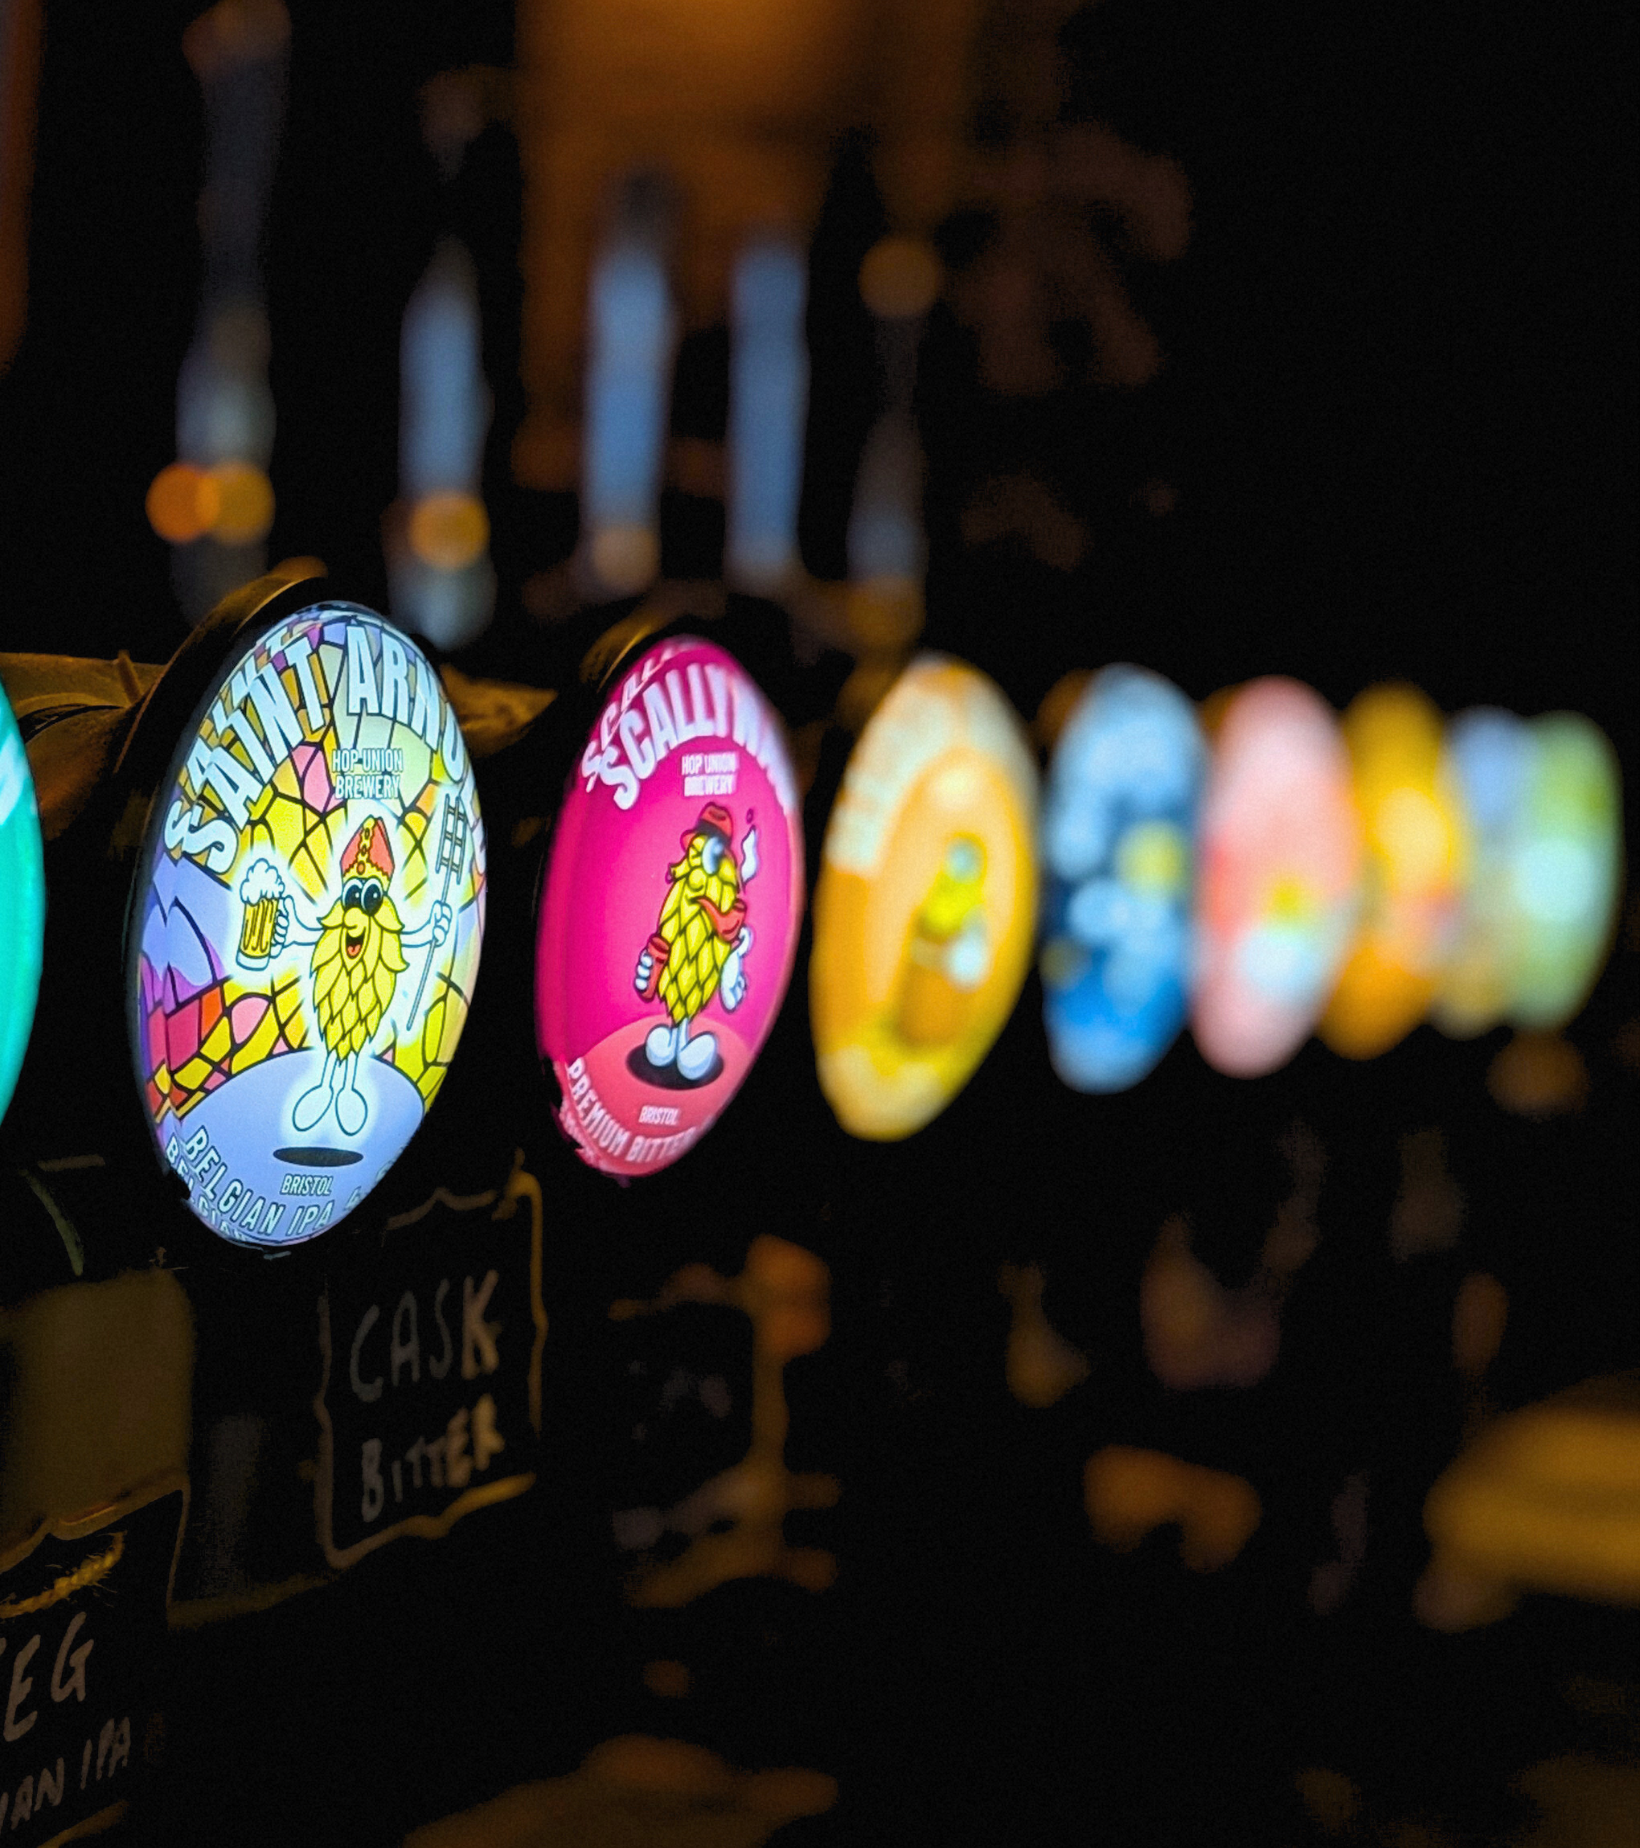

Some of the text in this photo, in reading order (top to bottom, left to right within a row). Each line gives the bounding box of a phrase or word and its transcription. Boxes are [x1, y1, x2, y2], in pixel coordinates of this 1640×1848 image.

[182, 636, 326, 875] SAINT
[332, 748, 403, 773] HOP UNION
[334, 774, 400, 800] BREWERY
[568, 1057, 631, 1158] PREMIUM
[639, 1105, 679, 1126] BRISTOL
[184, 1124, 286, 1236] BELGIAN
[286, 1200, 335, 1237] IPA
[280, 1173, 333, 1197] BRISTOL
[350, 1269, 501, 1402] CASK
[361, 1393, 505, 1523] BITTER
